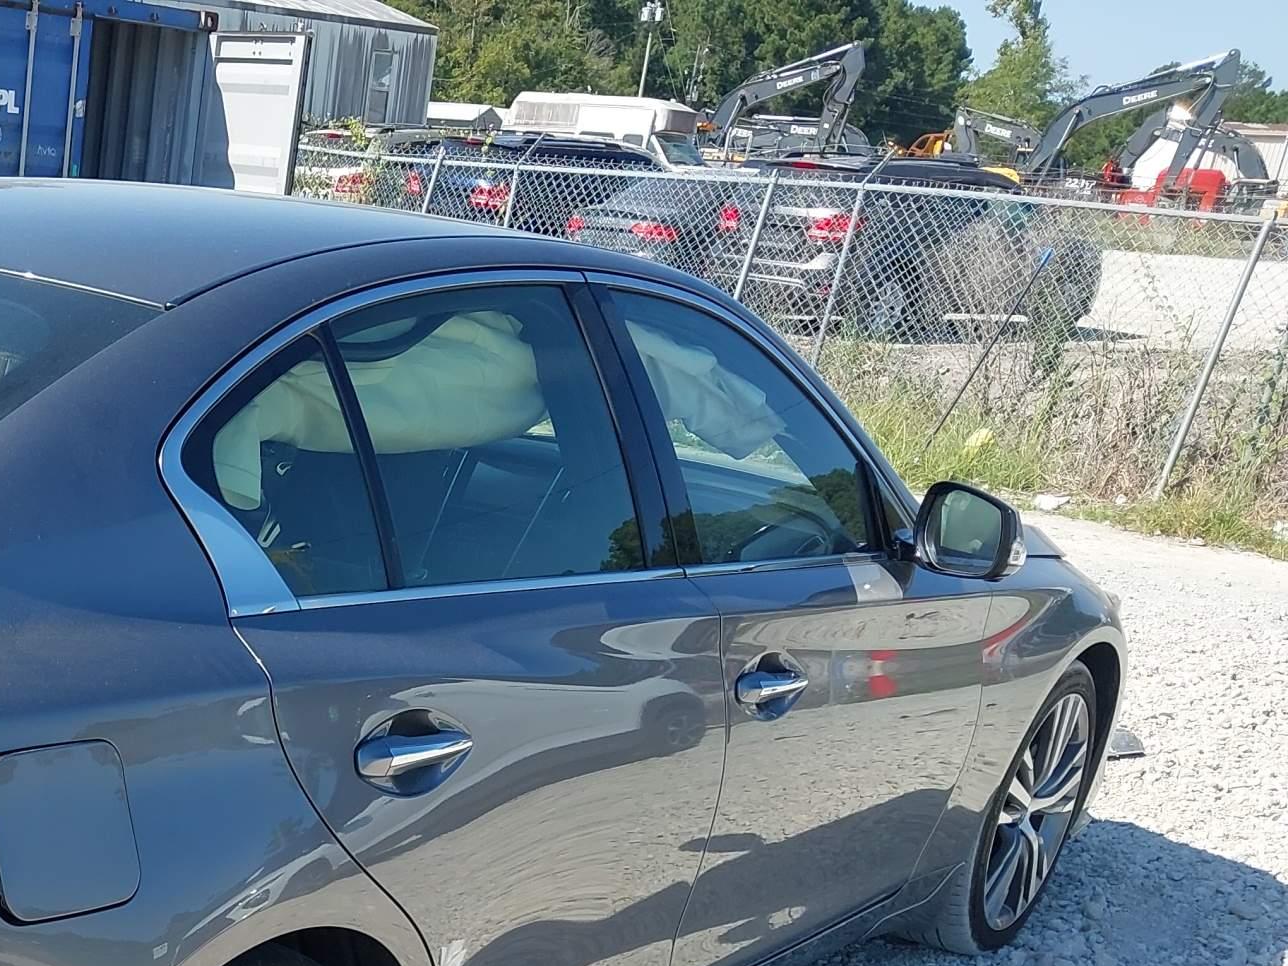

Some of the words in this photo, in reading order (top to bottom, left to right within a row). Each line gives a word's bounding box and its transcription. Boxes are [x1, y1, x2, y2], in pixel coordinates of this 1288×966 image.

[776, 75, 804, 90] DEERE
[1122, 89, 1158, 105] DEERE
[790, 124, 819, 136] DEER
[984, 123, 1012, 139] DEERE
